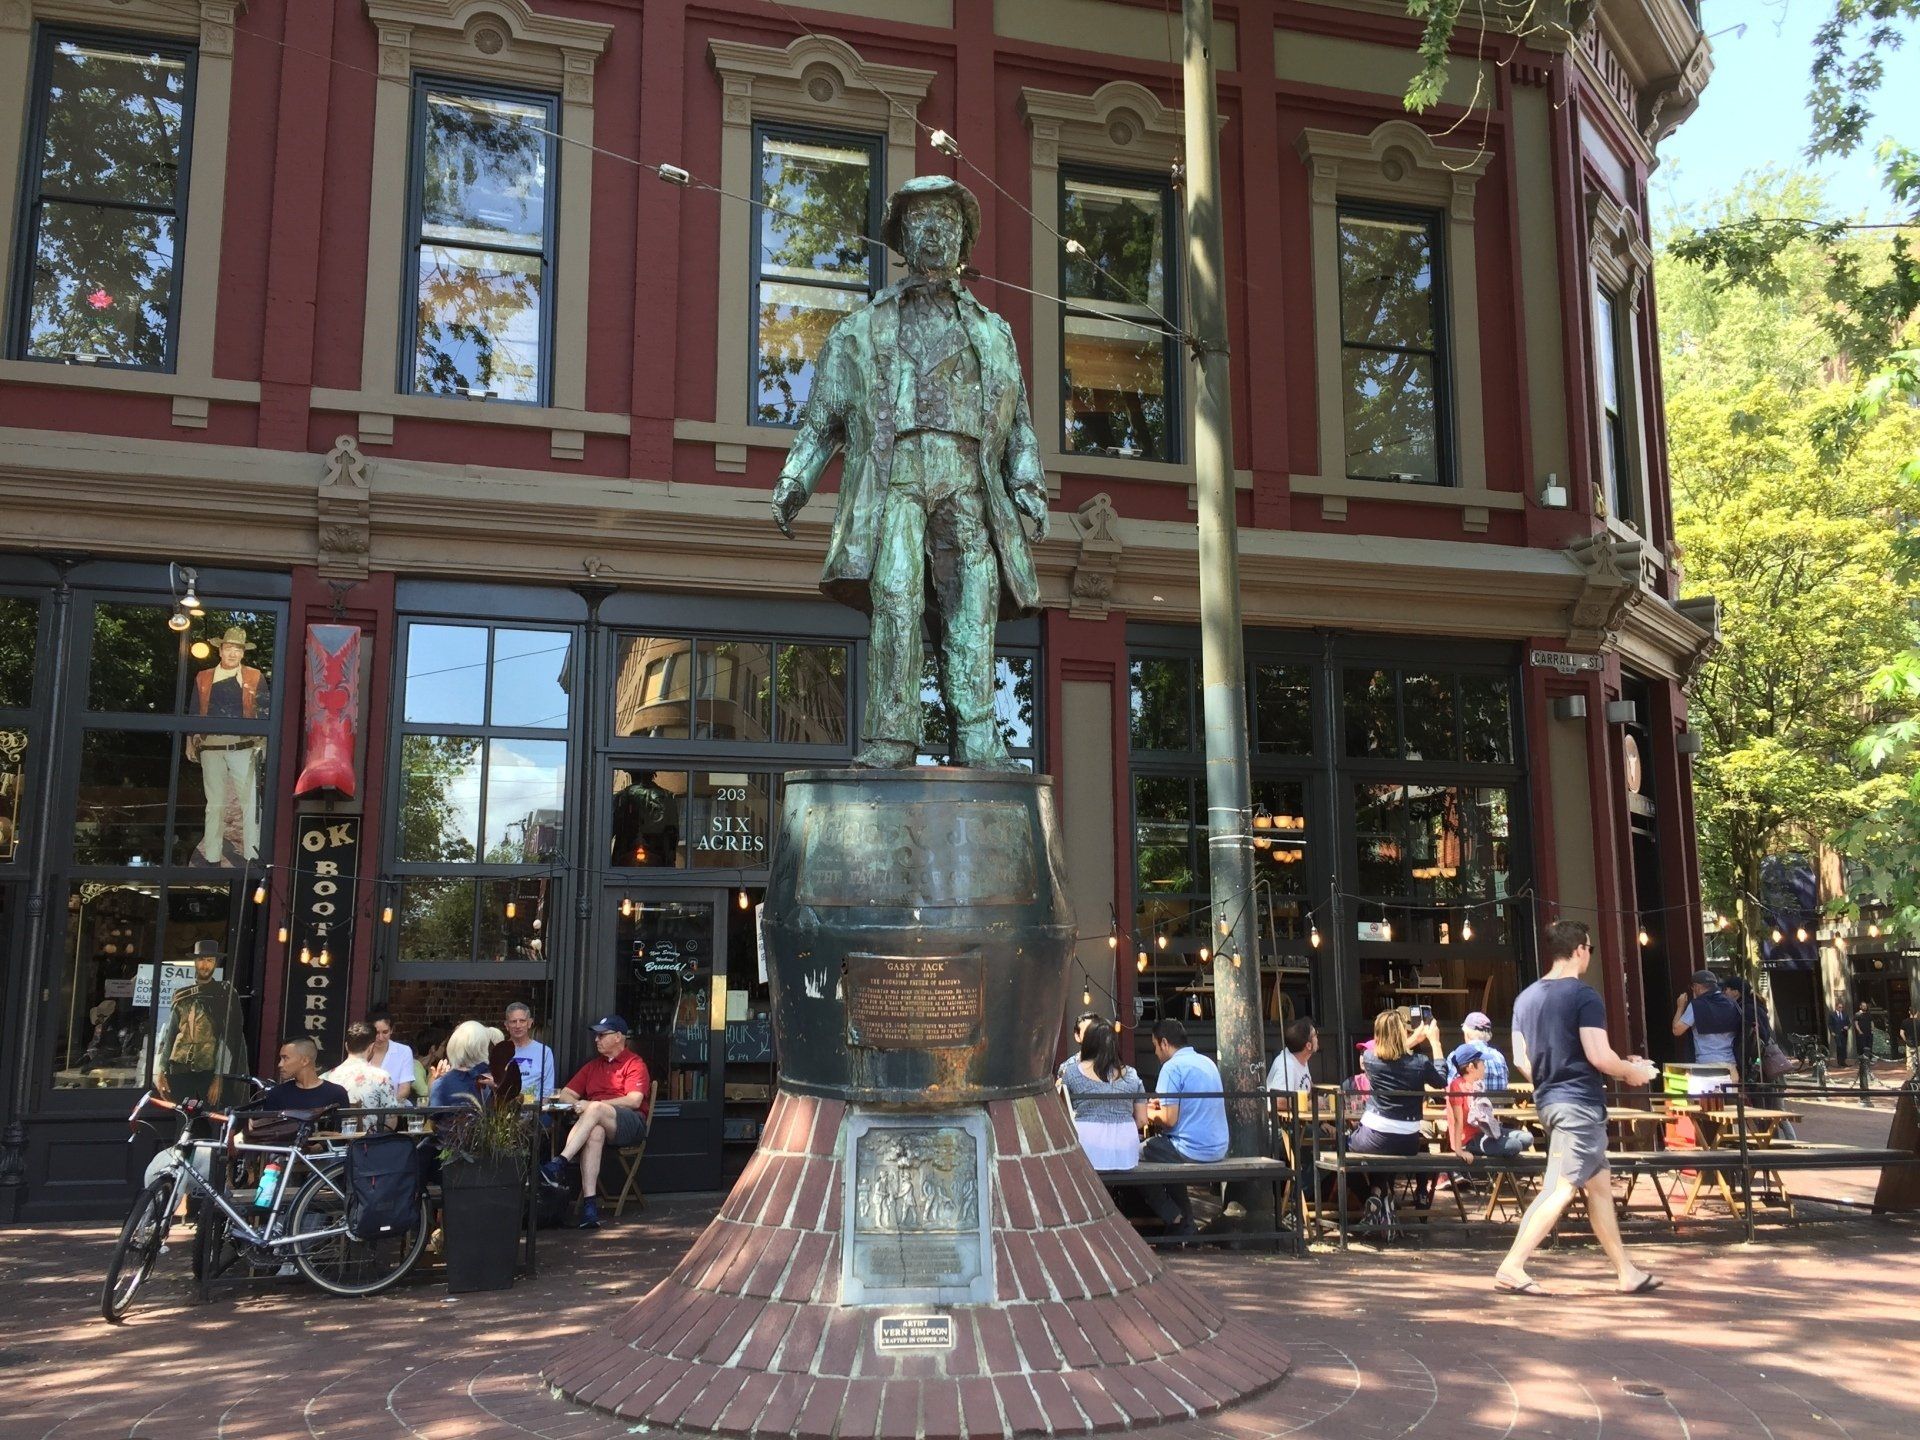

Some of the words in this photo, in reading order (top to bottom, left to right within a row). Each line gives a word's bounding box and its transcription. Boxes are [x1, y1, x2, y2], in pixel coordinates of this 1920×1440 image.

[1534, 652, 1577, 666] CARRALL
[717, 788, 746, 801] 203
[712, 816, 750, 833] SIX
[302, 823, 355, 852] OK
[697, 834, 764, 851] ACRES
[311, 860, 339, 936] BOOT
[164, 967, 197, 979] SAL
[644, 962, 687, 971] Brunch!
[883, 1328, 908, 1337] VERN
[910, 1327, 948, 1336] SIMPSON
